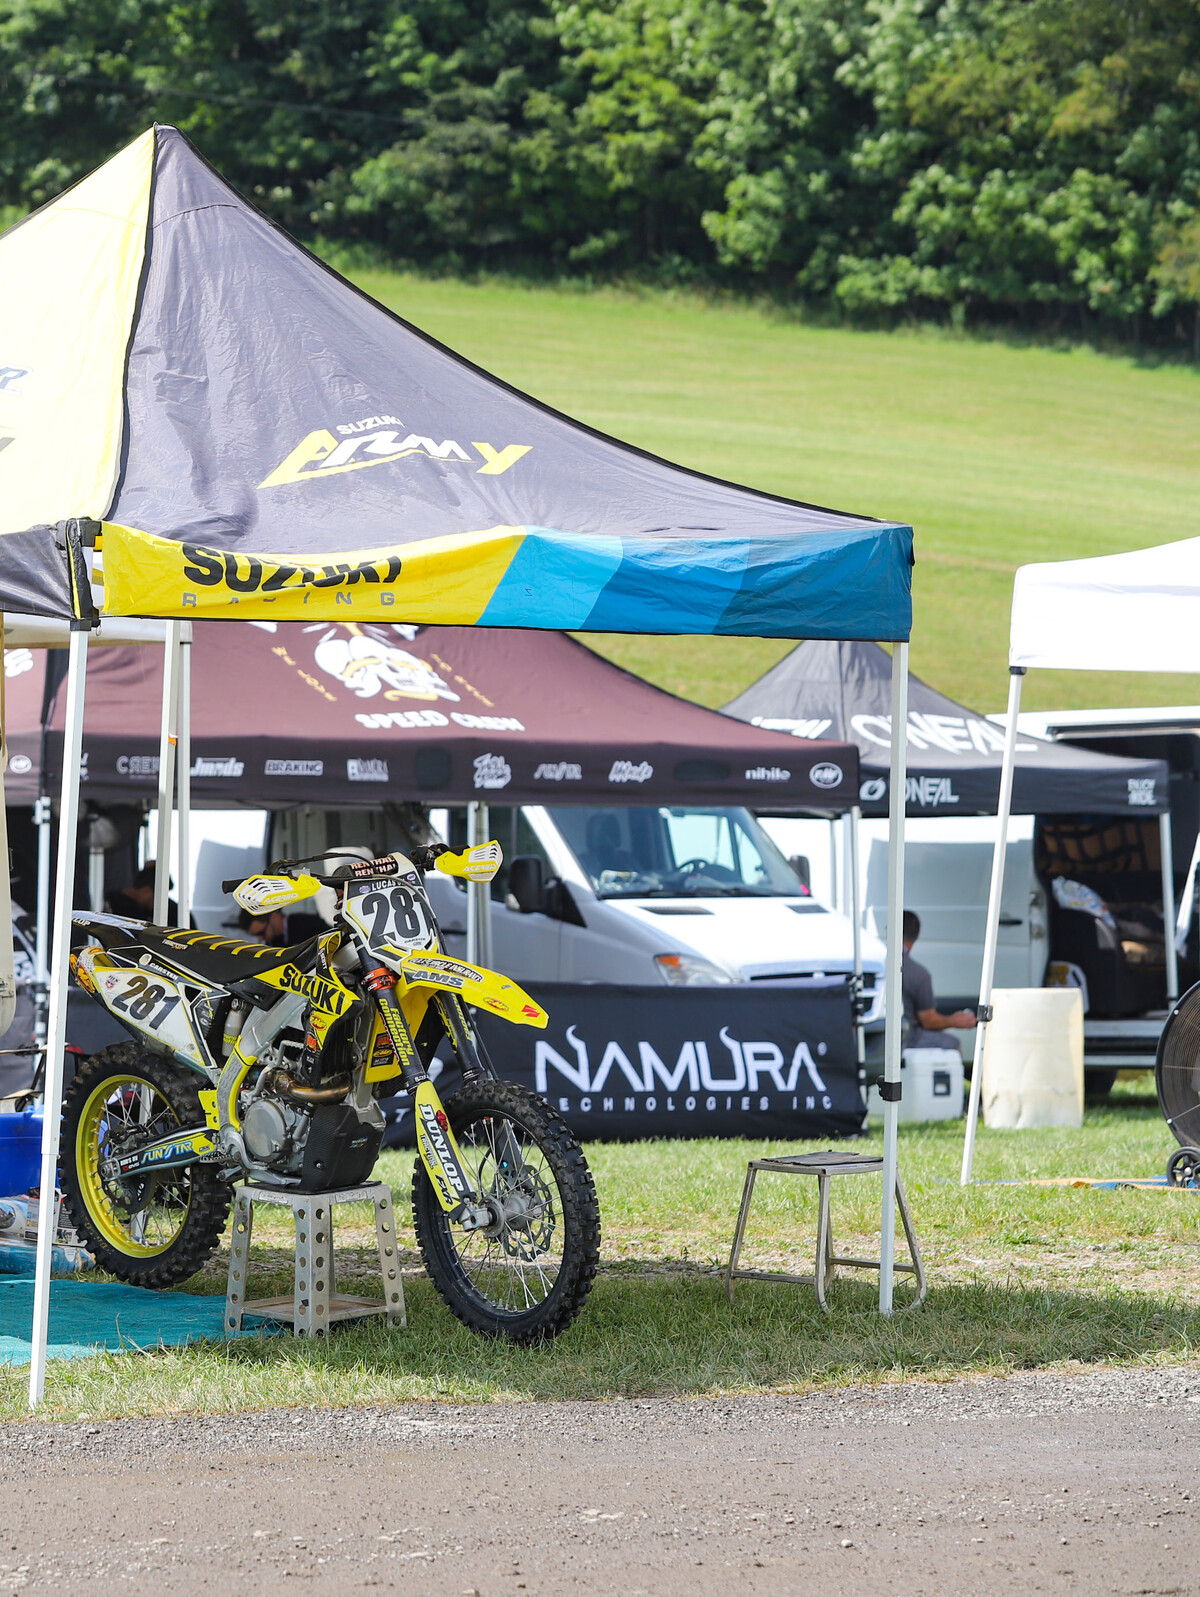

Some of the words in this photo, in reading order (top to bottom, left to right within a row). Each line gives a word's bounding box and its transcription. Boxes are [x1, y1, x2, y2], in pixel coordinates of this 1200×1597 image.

[335, 414, 405, 435] SUZUKI
[182, 541, 403, 593] SUZUKI
[354, 709, 450, 729] SPEED
[264, 759, 323, 776] BRAKING
[370, 880, 398, 893] LUCAS
[362, 888, 436, 949] 281
[149, 961, 179, 981] CARSTEN
[413, 970, 465, 987] AMS
[279, 964, 346, 1016] SUZUKI
[111, 975, 182, 1030] 281
[535, 1025, 827, 1093] NAMURA
[545, 1096, 770, 1112] ECHNOLOGIES
[419, 1104, 464, 1192] DUNLOP
